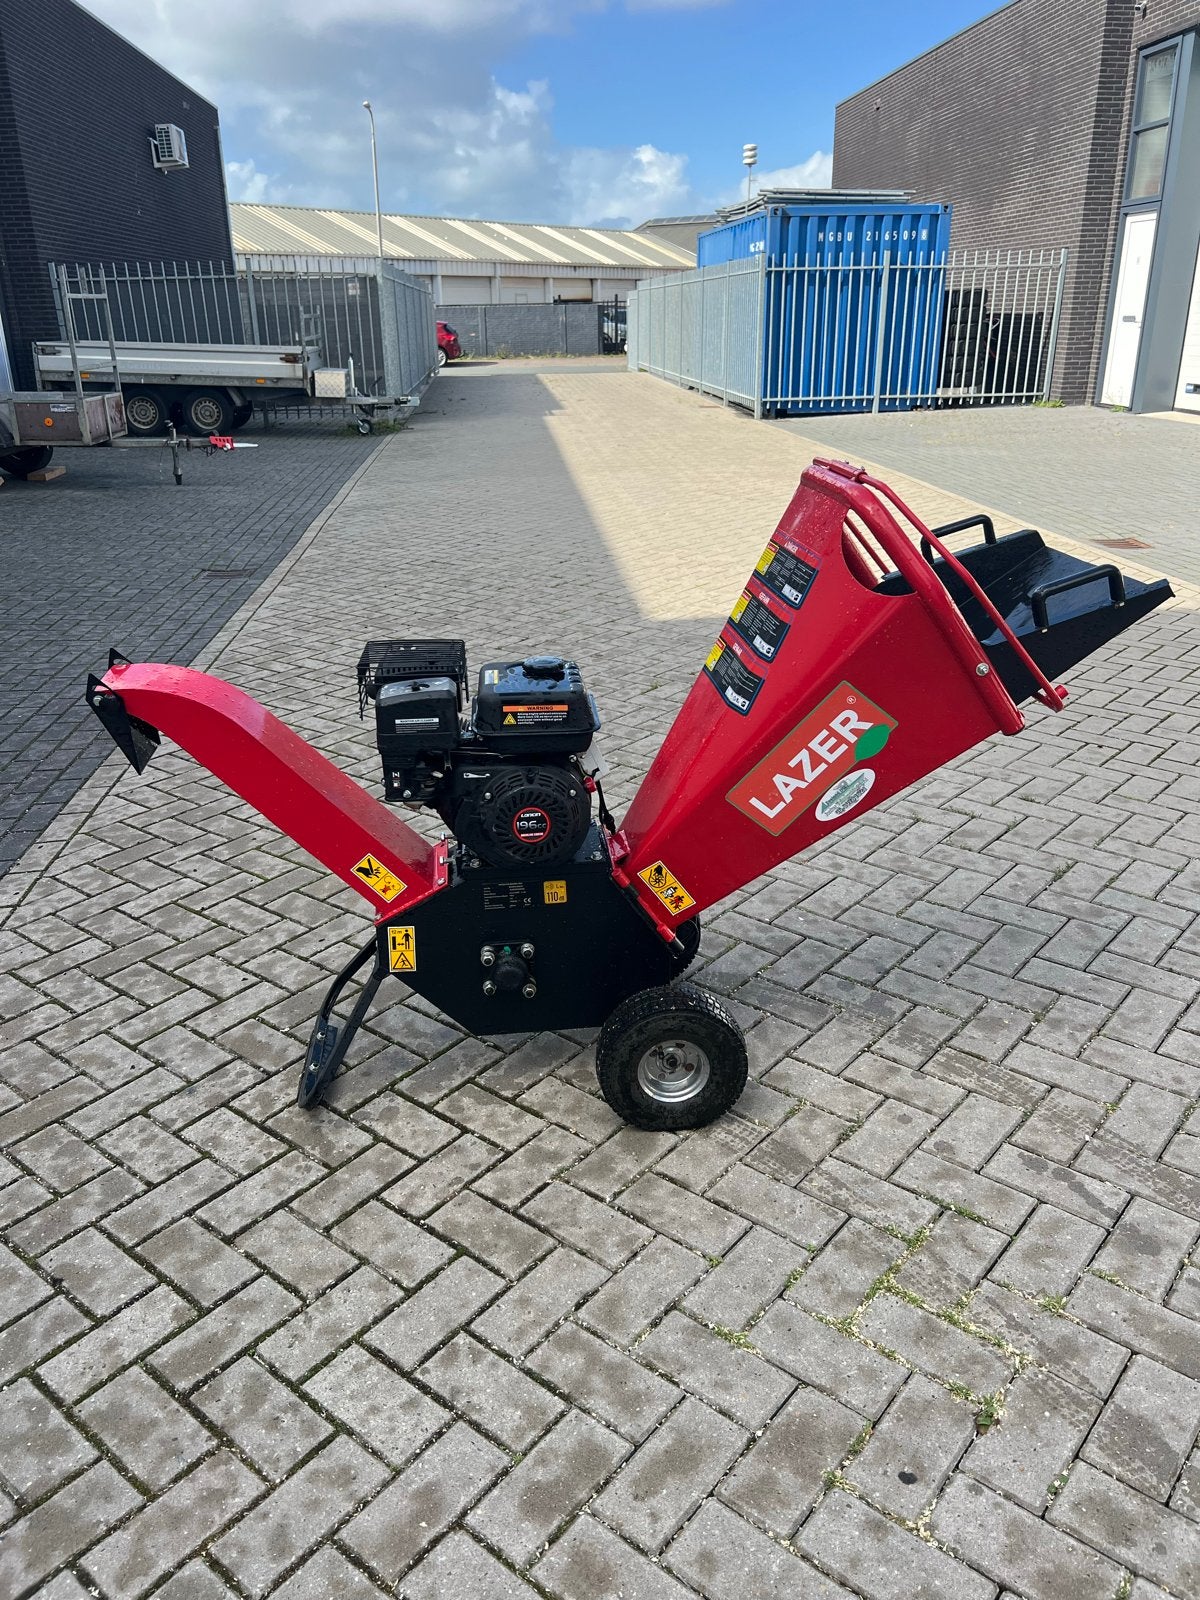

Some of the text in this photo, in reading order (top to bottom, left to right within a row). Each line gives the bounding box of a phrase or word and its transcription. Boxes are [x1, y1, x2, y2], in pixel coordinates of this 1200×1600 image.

[818, 231, 853, 242] MGBU
[749, 709, 874, 819] LAZER
[546, 891, 559, 902] 110
